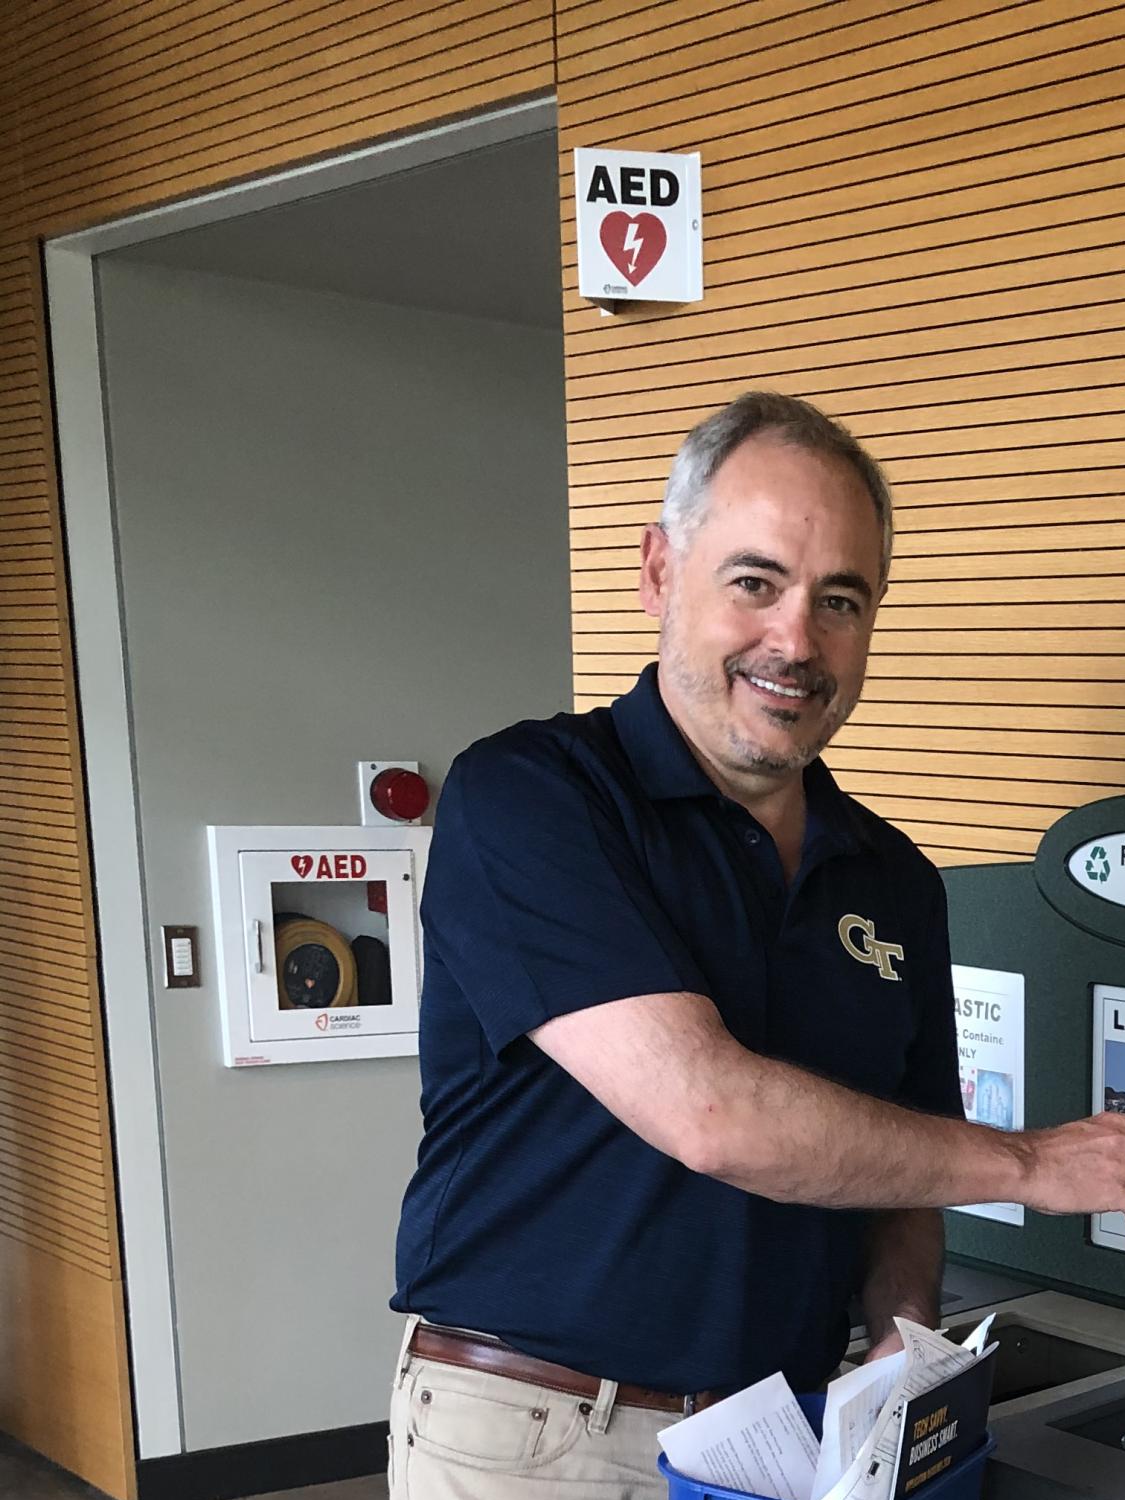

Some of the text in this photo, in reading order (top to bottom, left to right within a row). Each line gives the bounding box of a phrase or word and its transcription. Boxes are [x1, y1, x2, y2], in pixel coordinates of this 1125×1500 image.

[586, 165, 680, 207] AED
[316, 854, 367, 879] AED
[838, 913, 904, 981] GT
[329, 1014, 361, 1023] CARDIAC
[954, 998, 1002, 1022] ASTIC
[959, 1046, 977, 1060] NLY
